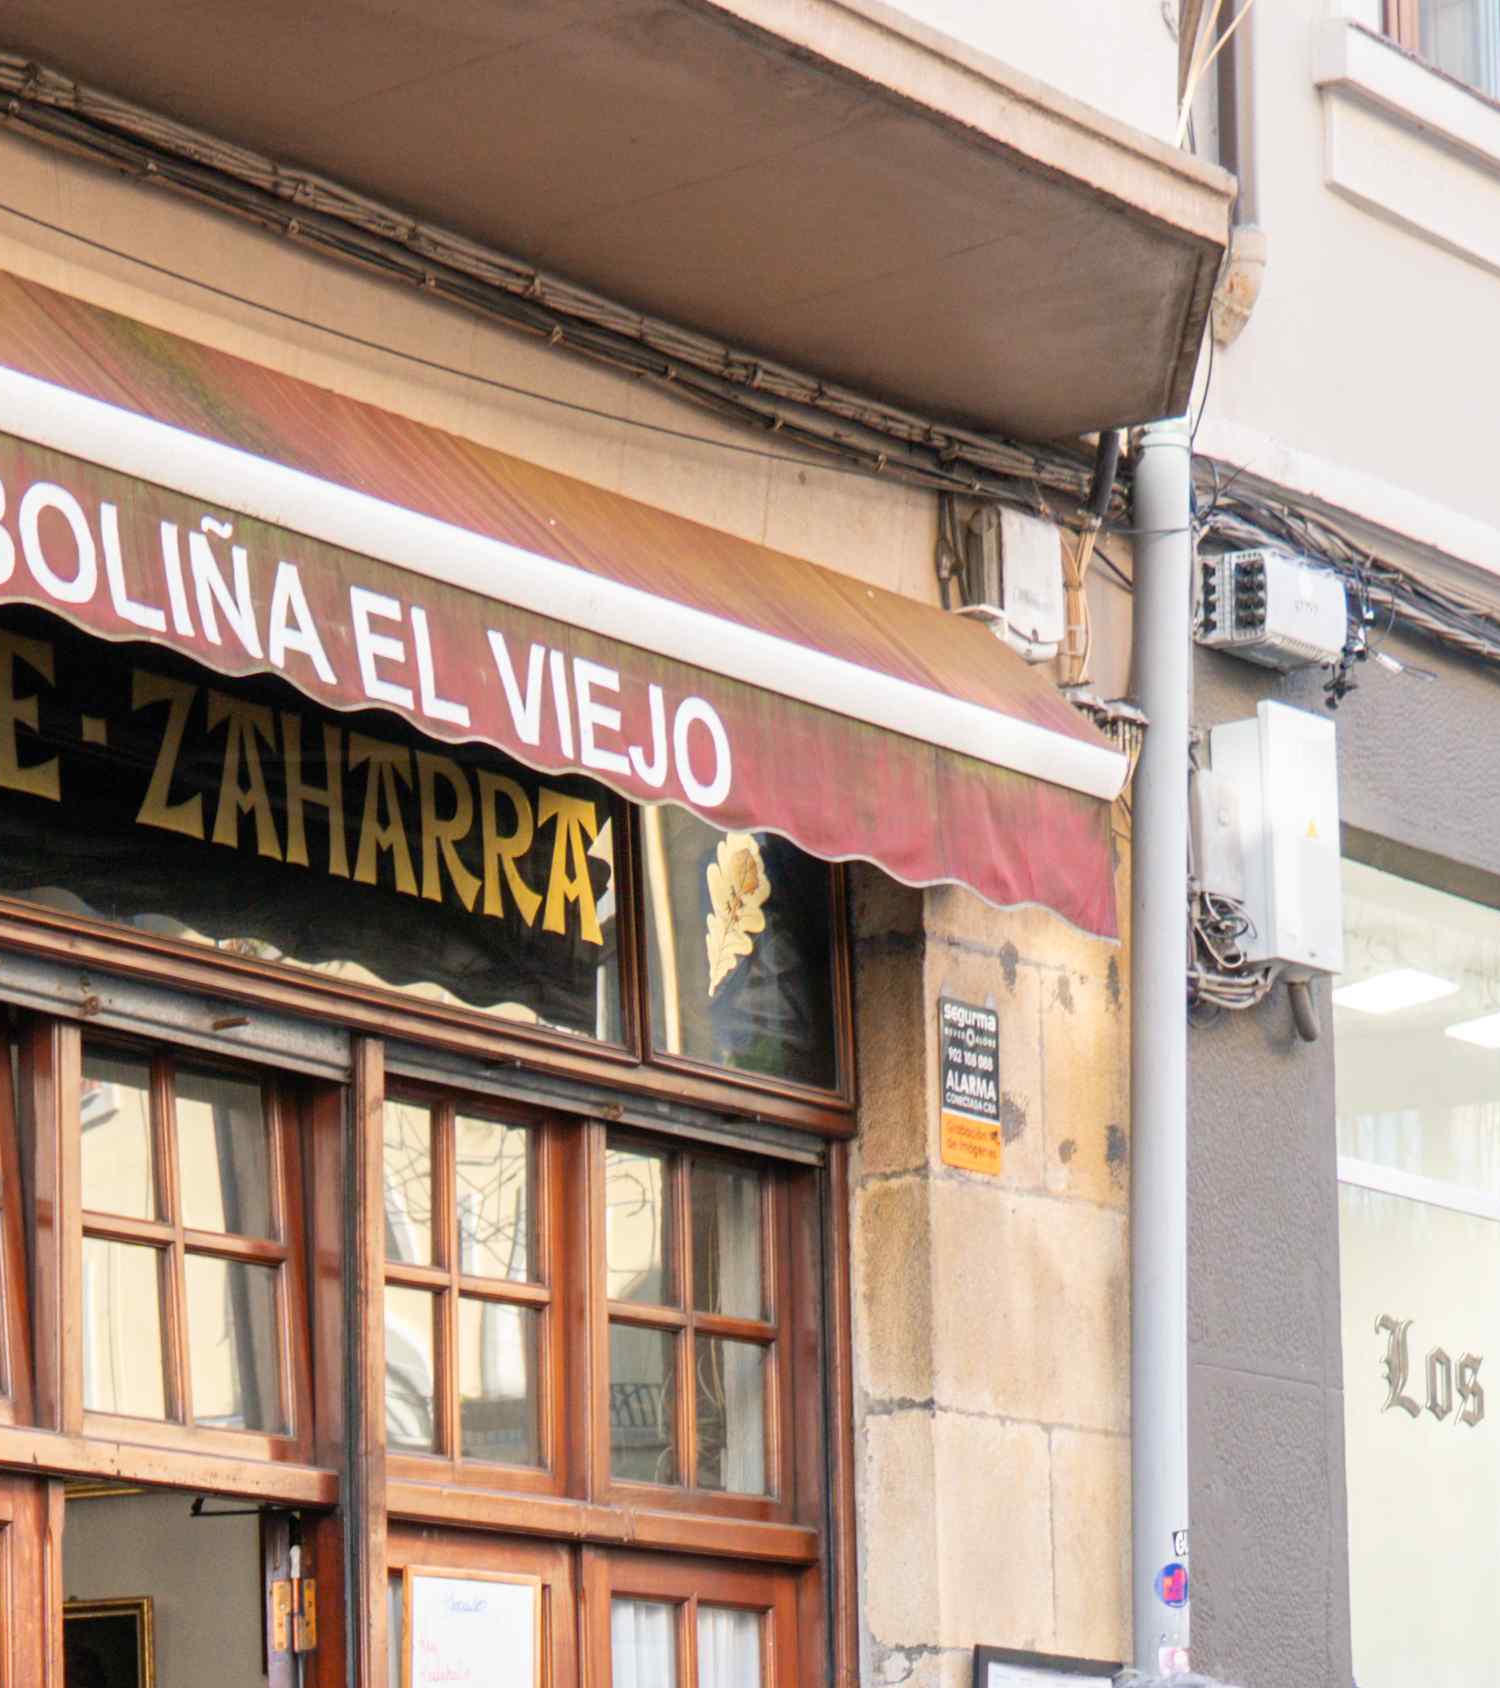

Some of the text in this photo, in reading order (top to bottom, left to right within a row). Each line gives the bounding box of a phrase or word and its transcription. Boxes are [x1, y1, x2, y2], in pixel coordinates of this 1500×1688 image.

[349, 584, 472, 728] EL
[487, 629, 733, 807] VIEJO
[130, 669, 604, 947] ZAHARRA
[943, 1002, 997, 1033] segurma
[945, 1069, 997, 1102] ALARMA
[1374, 1312, 1485, 1428] Los
